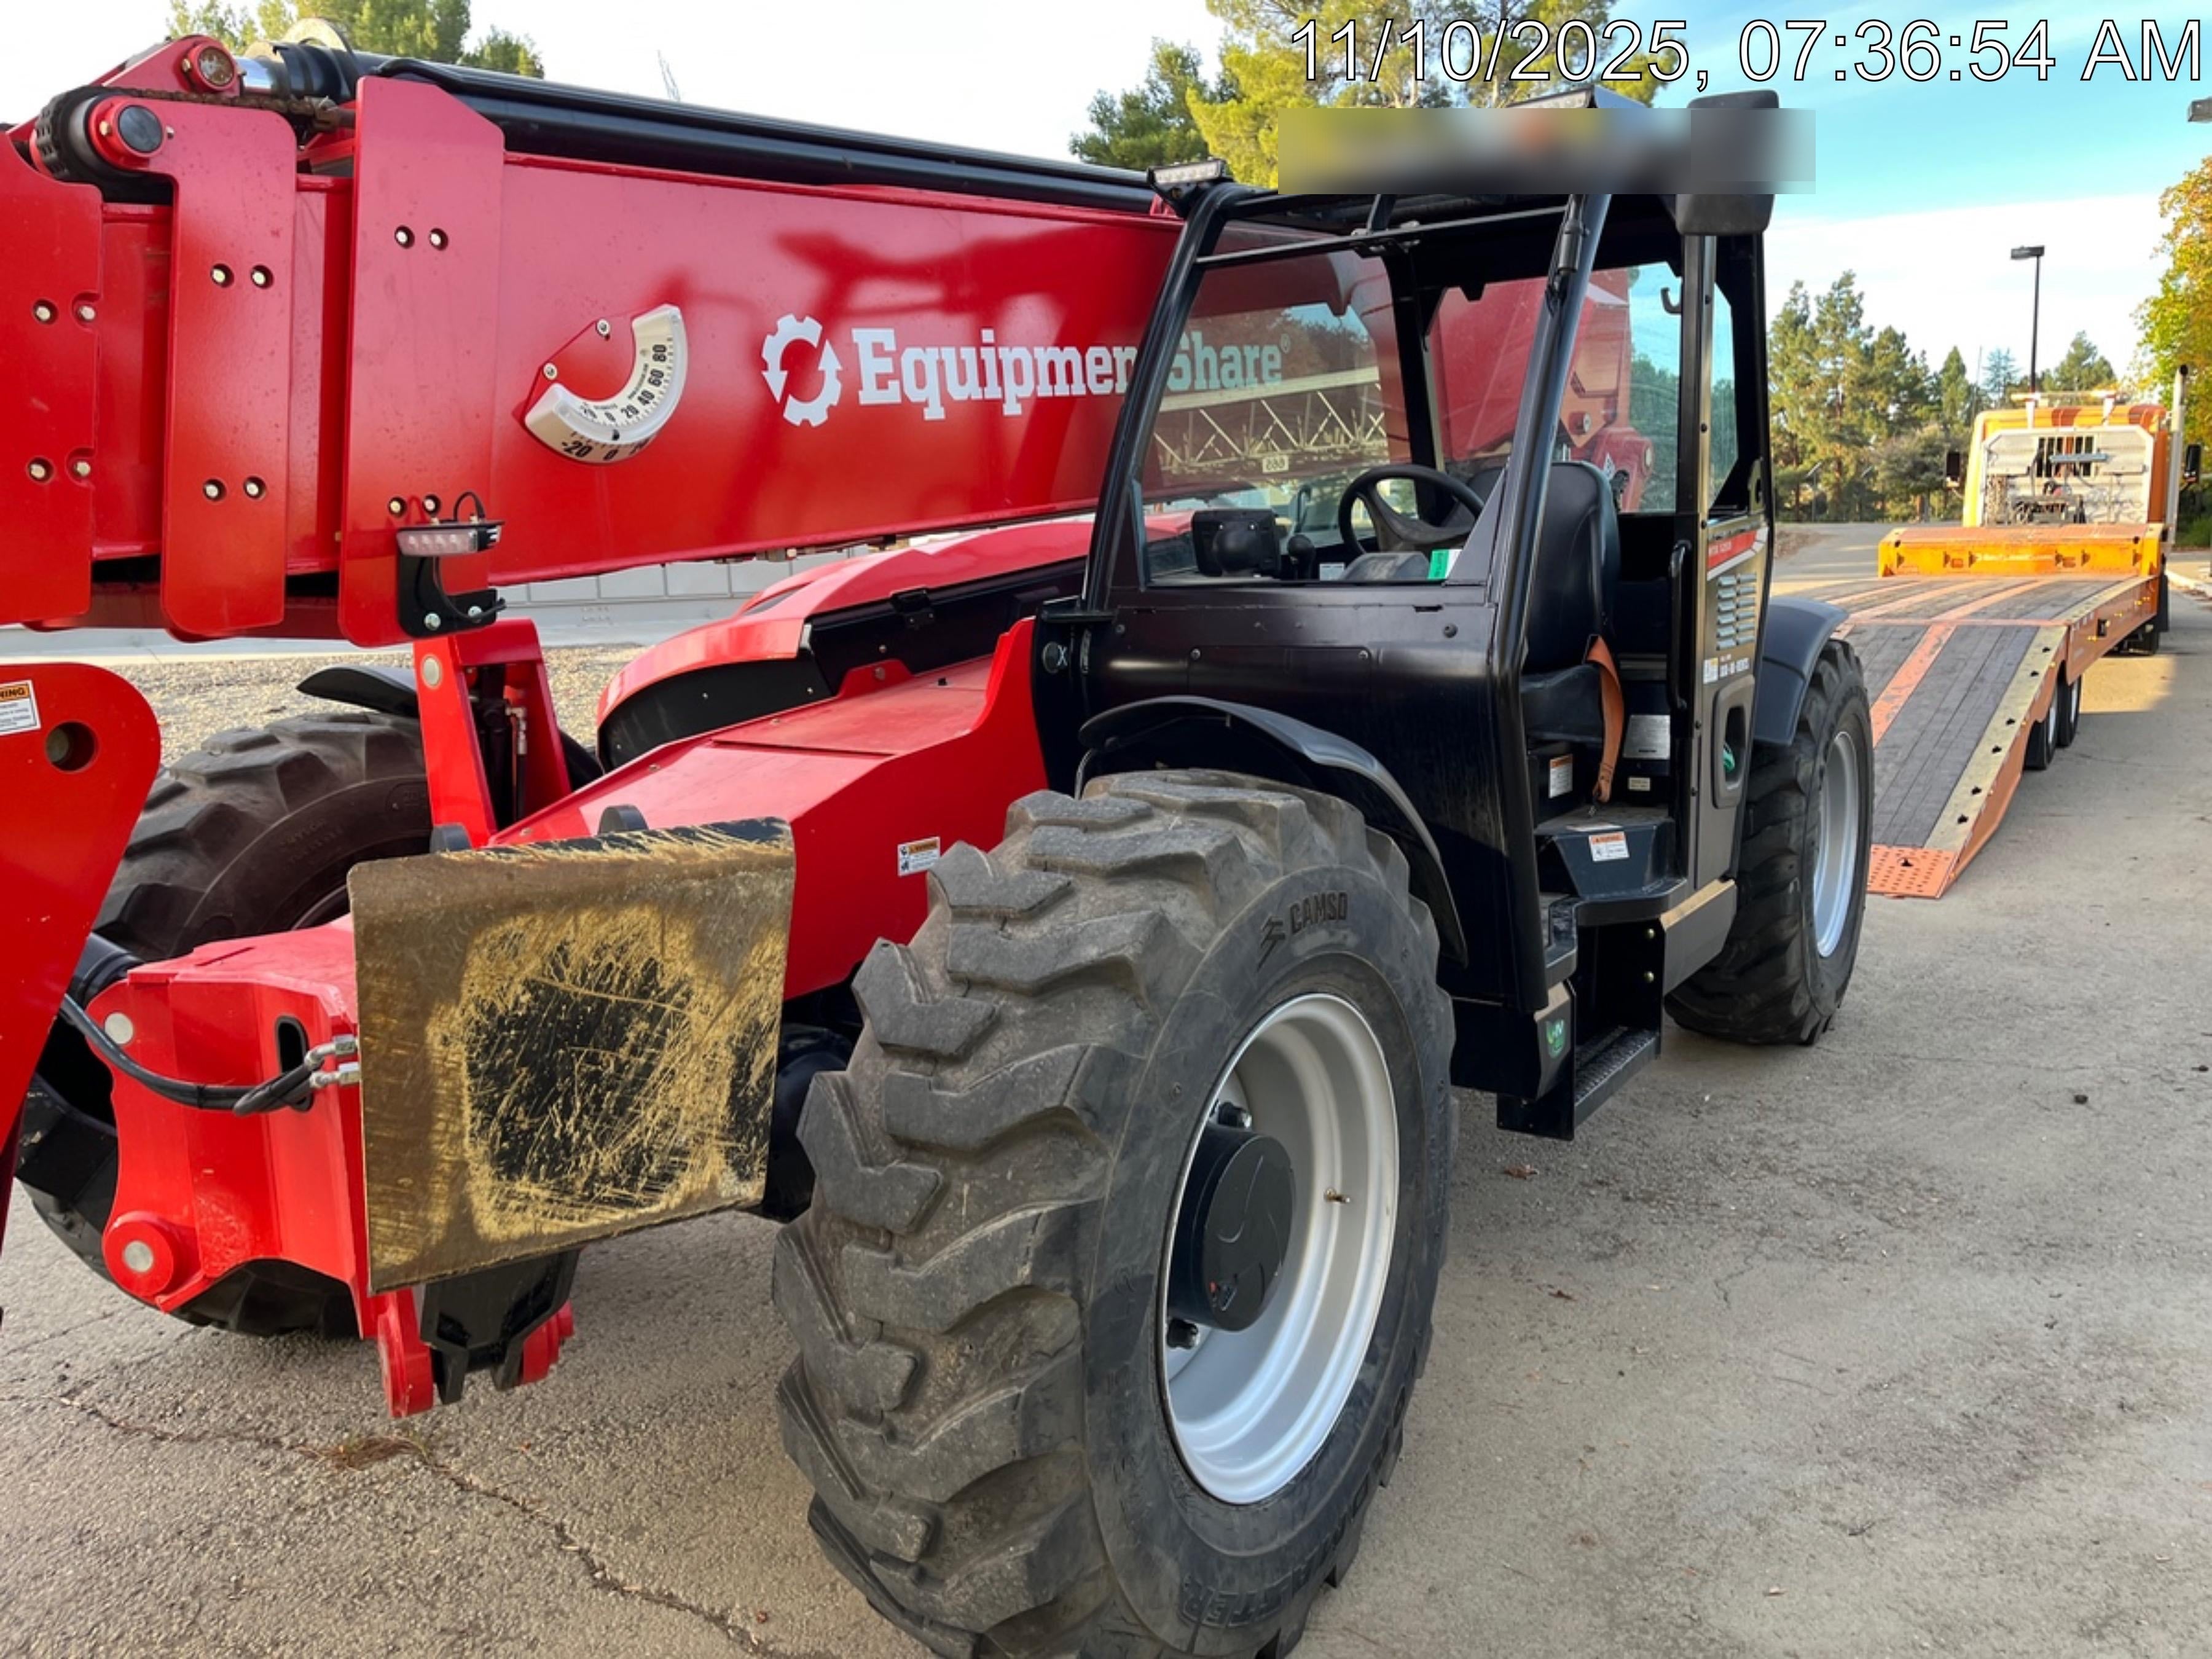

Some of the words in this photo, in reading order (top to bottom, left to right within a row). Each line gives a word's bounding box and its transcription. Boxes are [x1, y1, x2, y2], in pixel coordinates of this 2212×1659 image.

[652, 344, 667, 362] 80
[648, 369, 664, 386] 60
[638, 390, 654, 406] 40
[621, 404, 640, 418] 20
[561, 440, 593, 458] -20
[603, 449, 619, 461] 0
